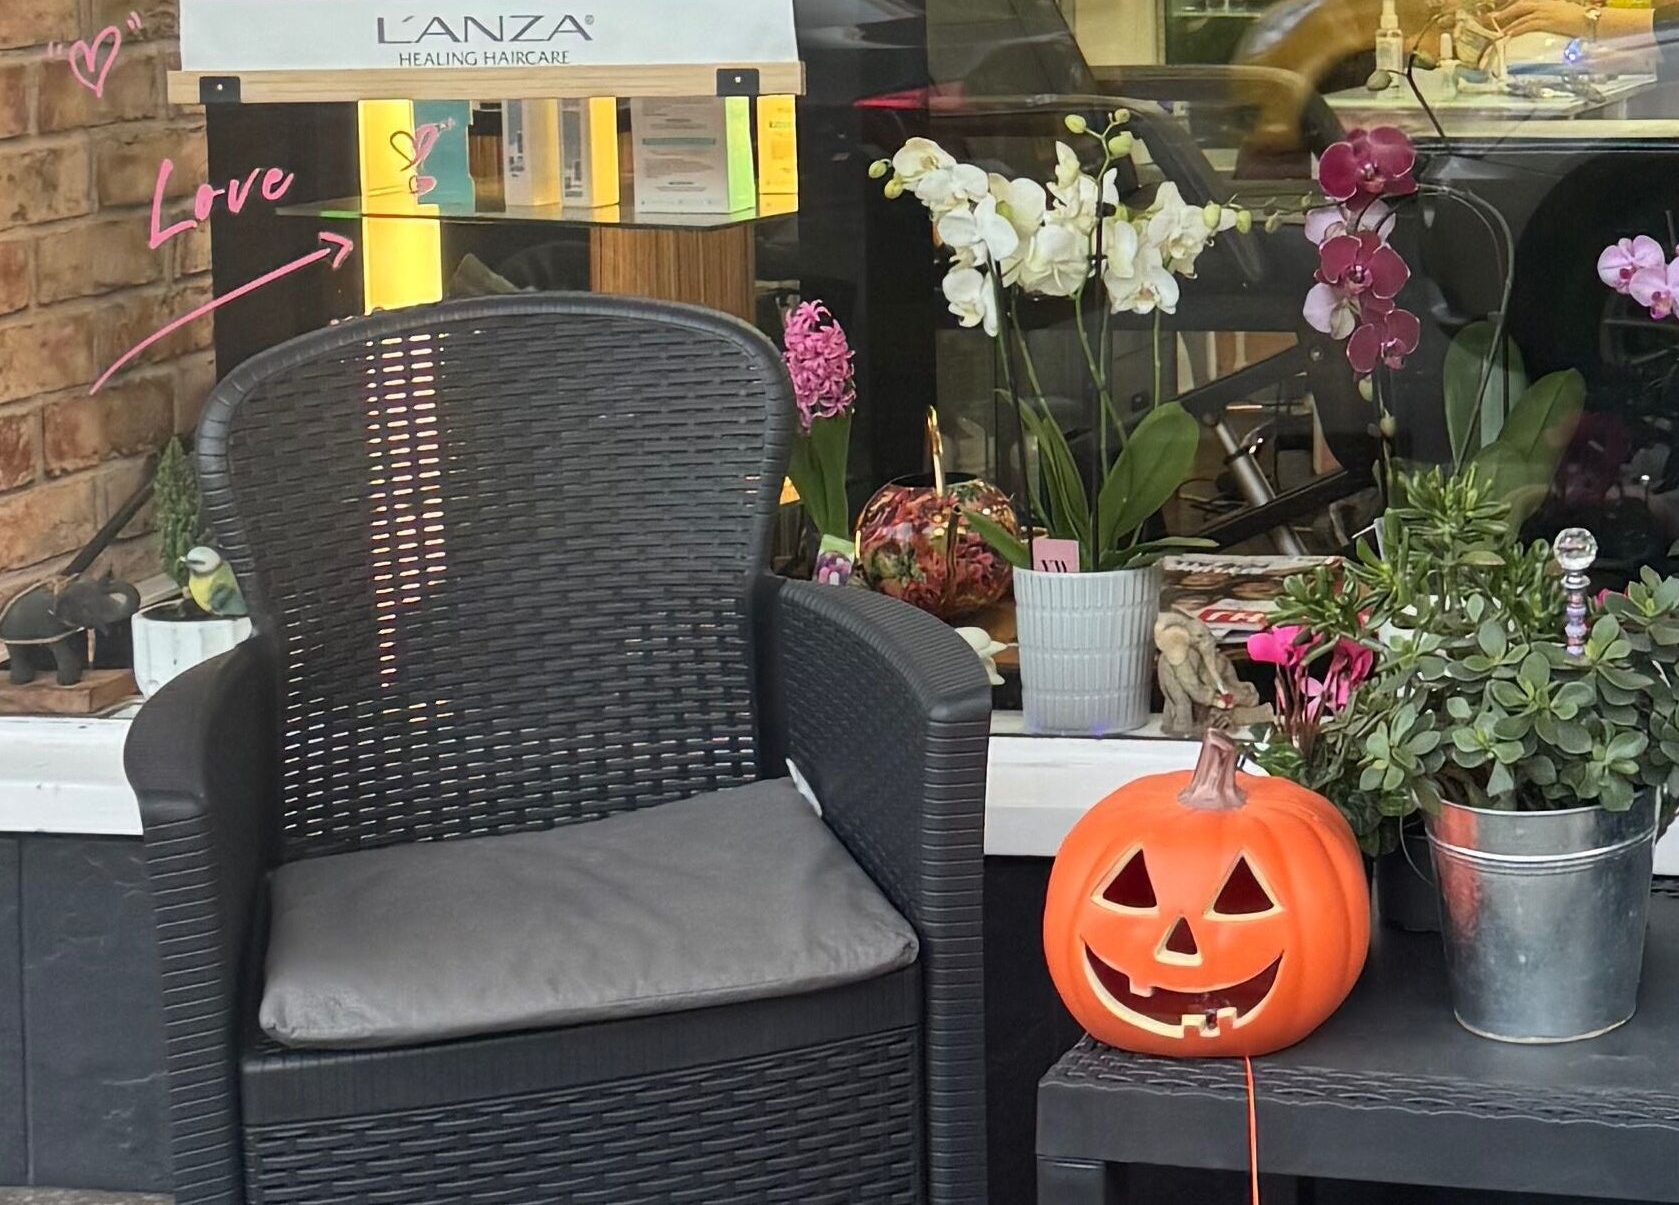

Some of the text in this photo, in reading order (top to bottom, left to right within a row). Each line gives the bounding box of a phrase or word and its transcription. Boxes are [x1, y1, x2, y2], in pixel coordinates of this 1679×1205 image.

[400, 50, 570, 66] HEALING HAIRCARE
[149, 158, 295, 249] Love
